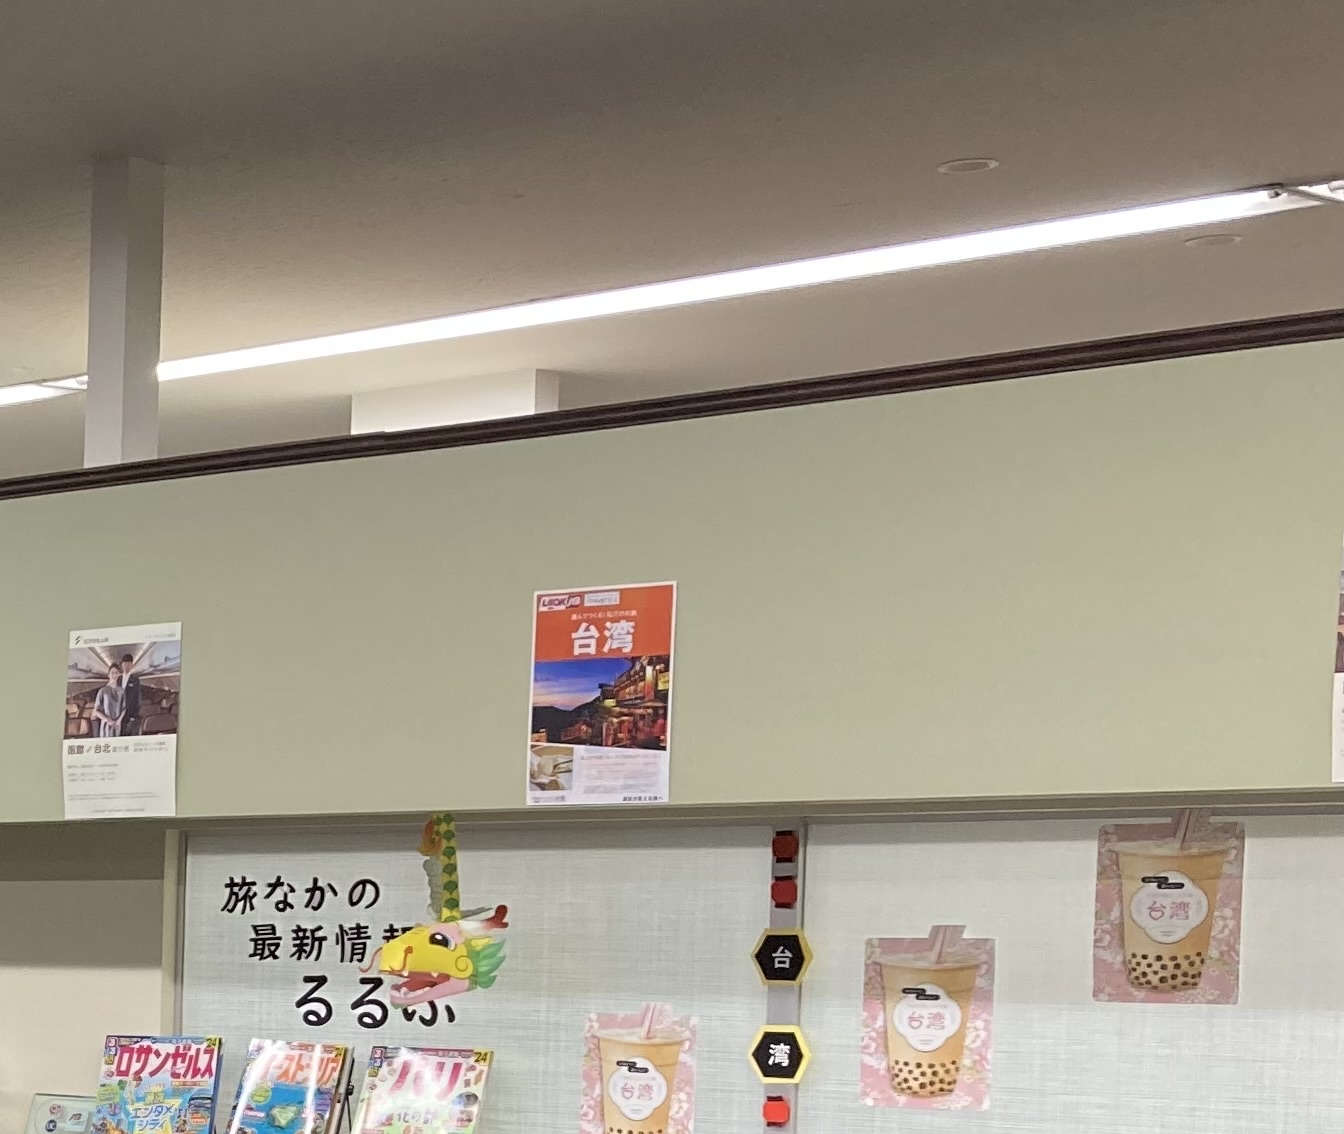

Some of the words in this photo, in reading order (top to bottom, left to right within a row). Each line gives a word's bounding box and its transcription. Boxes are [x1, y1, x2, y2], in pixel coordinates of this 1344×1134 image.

[572, 620, 636, 655] 台湾
[221, 875, 380, 915] 旅なかの
[1147, 902, 1191, 921] 台湾
[772, 946, 793, 968] 台
[907, 1012, 946, 1031] 台湾
[116, 1044, 214, 1079] ロサンゼルス
[768, 1043, 790, 1067] 湾
[621, 1082, 653, 1100] 台湾
